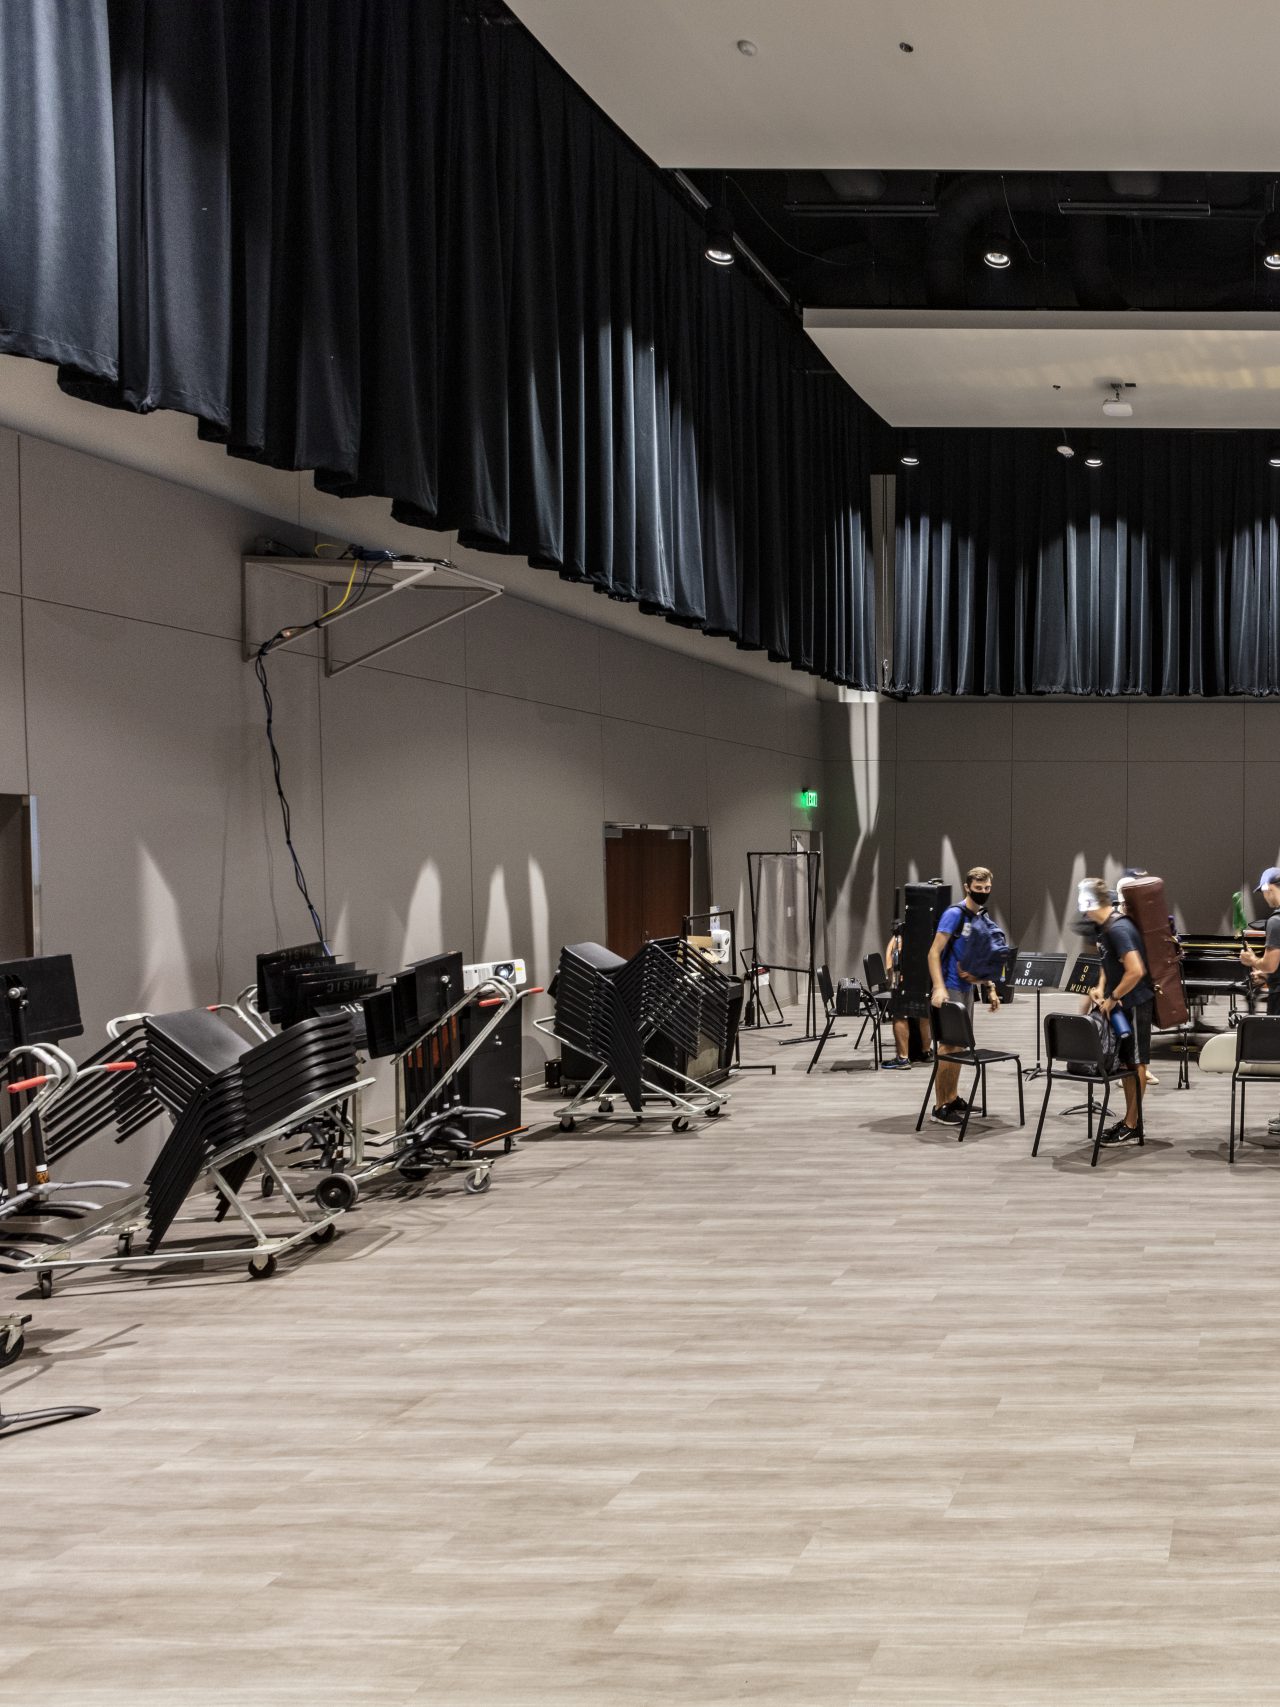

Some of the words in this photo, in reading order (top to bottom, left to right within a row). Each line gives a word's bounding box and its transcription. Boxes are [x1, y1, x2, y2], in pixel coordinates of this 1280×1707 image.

[1014, 978, 1044, 986] MUSIC
[1079, 974, 1086, 982] S
[326, 977, 369, 993] MUSIC
